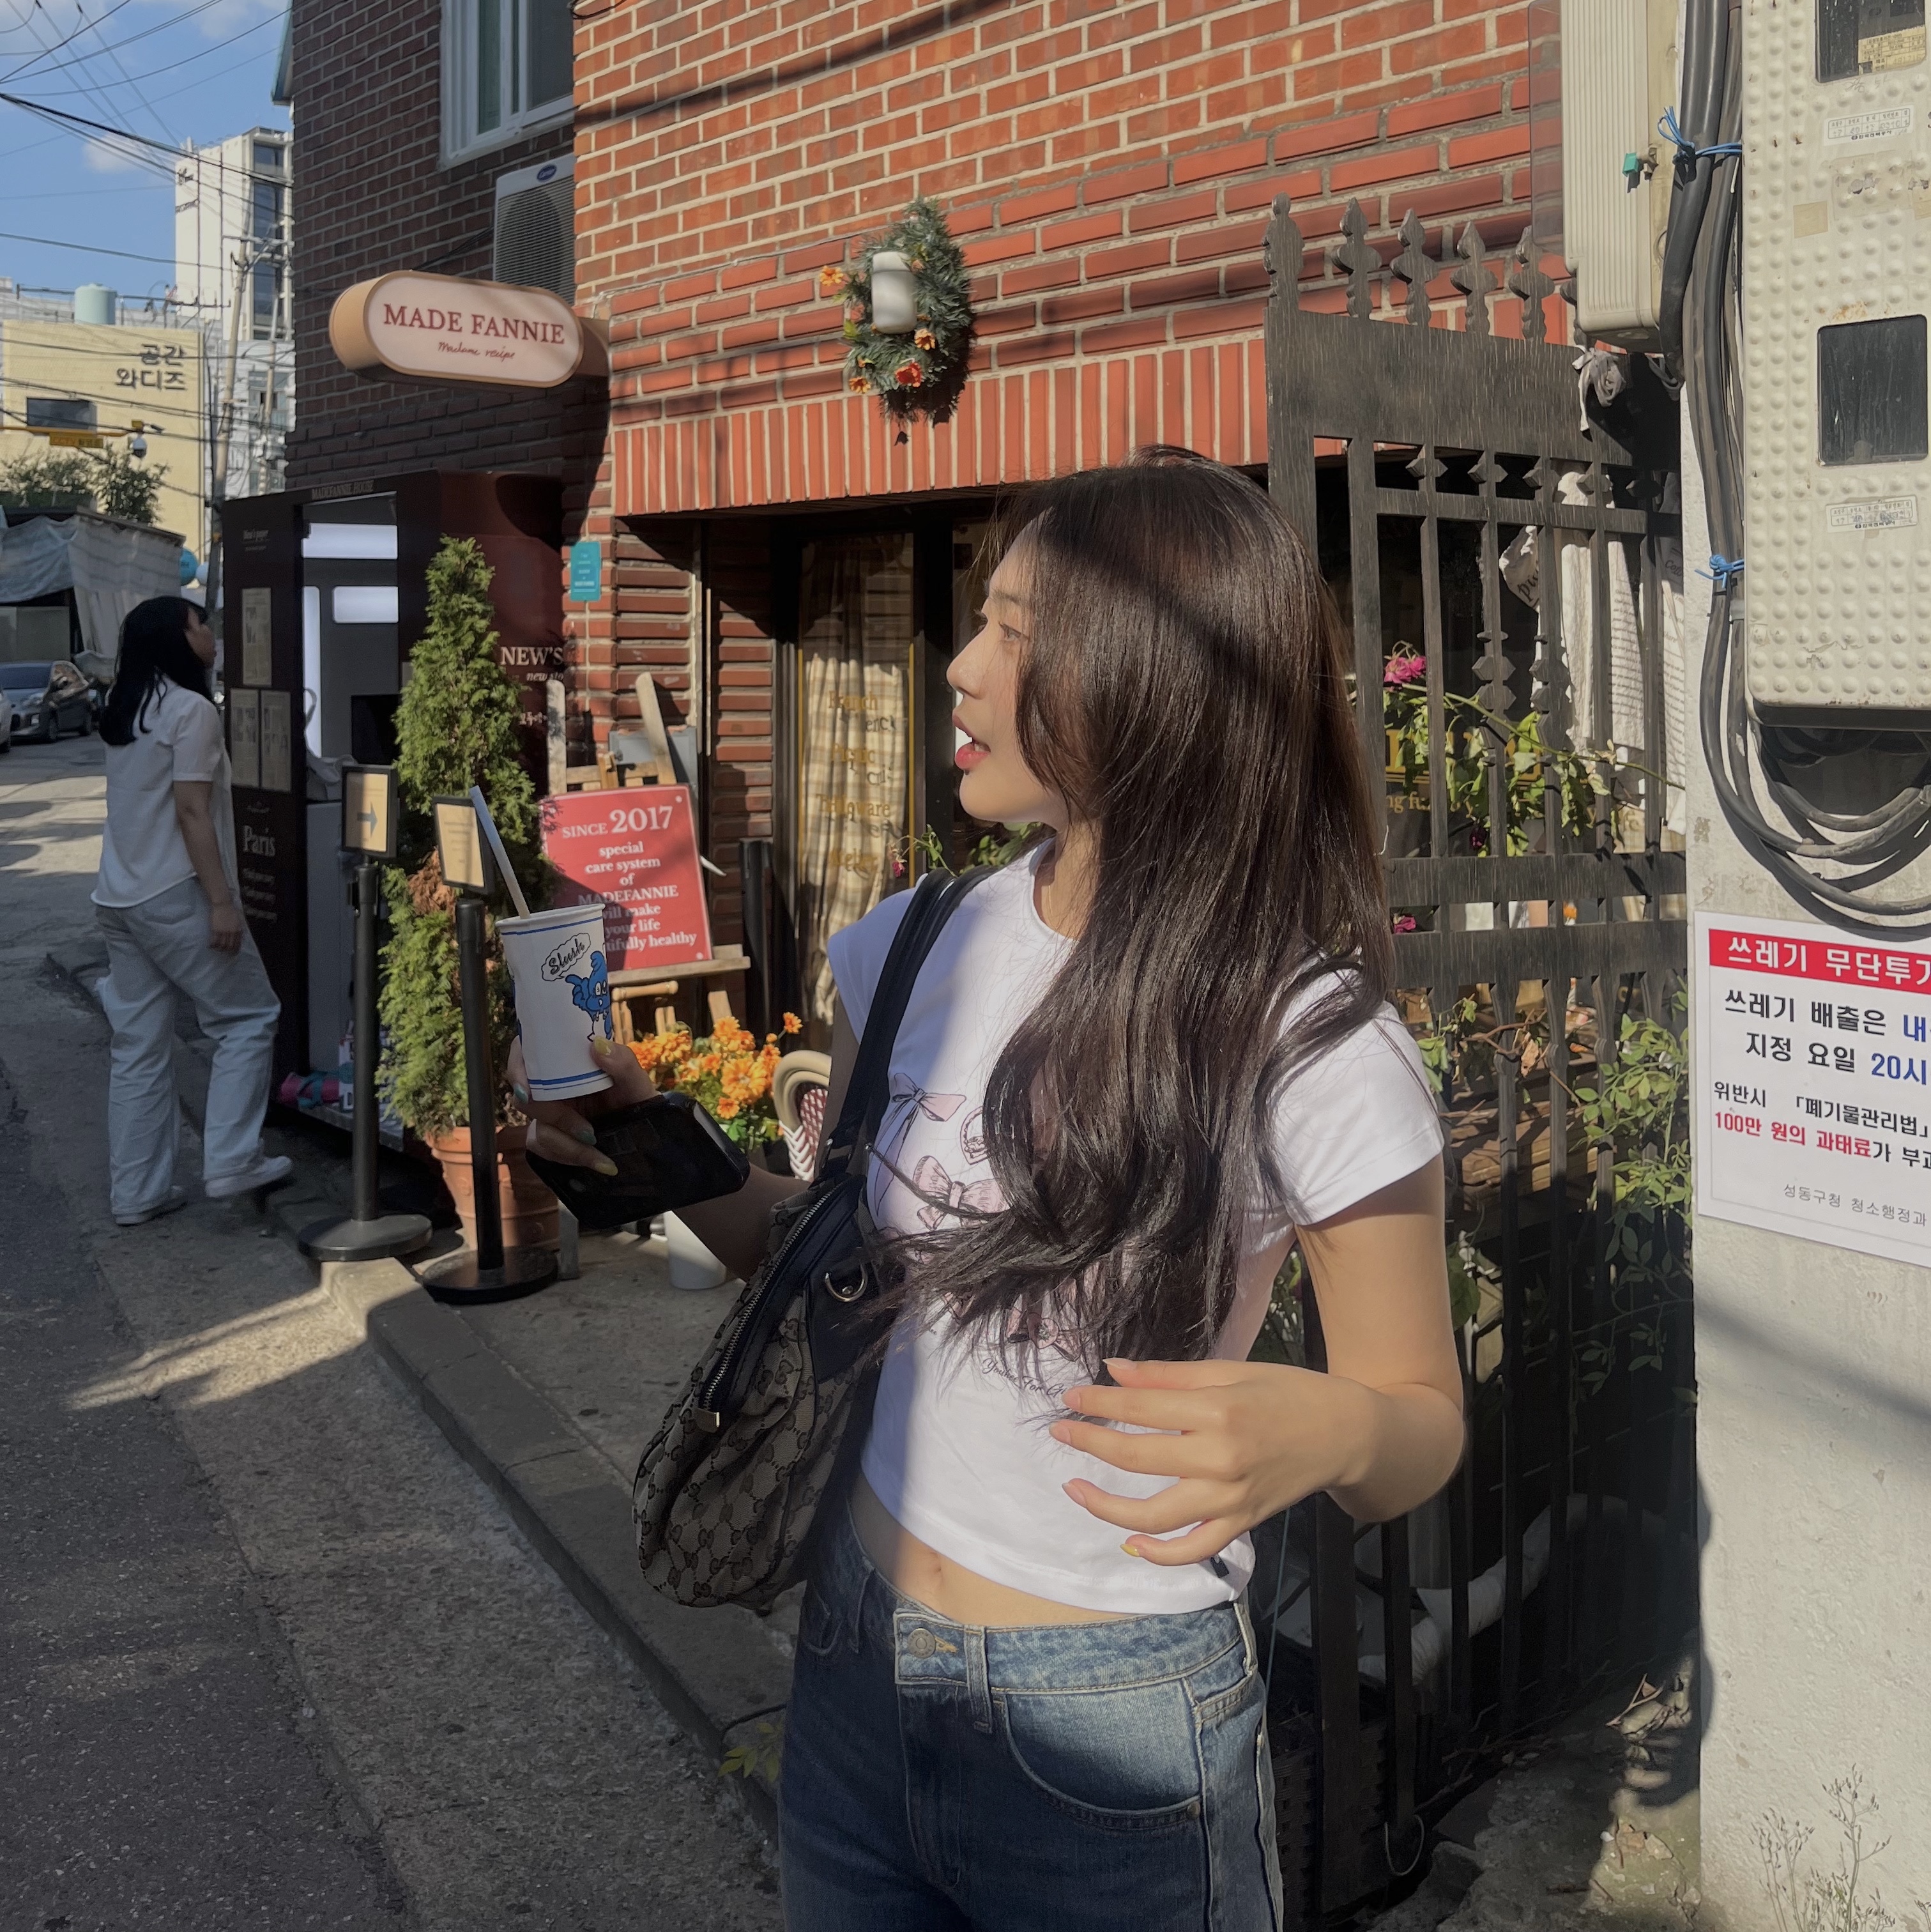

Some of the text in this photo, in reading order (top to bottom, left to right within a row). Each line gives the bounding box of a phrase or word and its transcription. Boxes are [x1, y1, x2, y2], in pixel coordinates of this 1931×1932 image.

[383, 303, 565, 344] MADE FANNIE
[139, 343, 187, 366] 공간
[116, 368, 187, 391] 와디즈
[828, 691, 878, 710] French
[562, 805, 673, 839] SINCE 2017
[243, 825, 276, 857] Paris
[599, 840, 644, 859] special
[585, 857, 661, 874] care system
[619, 872, 634, 887] of
[578, 885, 679, 905] MADEFANNIE
[625, 903, 662, 917] make
[604, 918, 661, 939] your life
[606, 931, 698, 953] tifully healthy
[1727, 937, 1808, 972] 쓰레기
[549, 939, 585, 976] Slush
[1725, 989, 1795, 1022] 쓰레기
[1811, 1000, 1886, 1036] 배출은
[1746, 1032, 1792, 1062] 지정
[1807, 1041, 1856, 1073] 요일
[1714, 1080, 1766, 1108] 위반시
[1714, 1112, 1762, 1137] 100만
[1771, 1122, 1806, 1146] 원의
[1816, 1130, 1891, 1163] 과태료가
[1783, 1183, 1927, 1227] 성동구청 청소행정과
